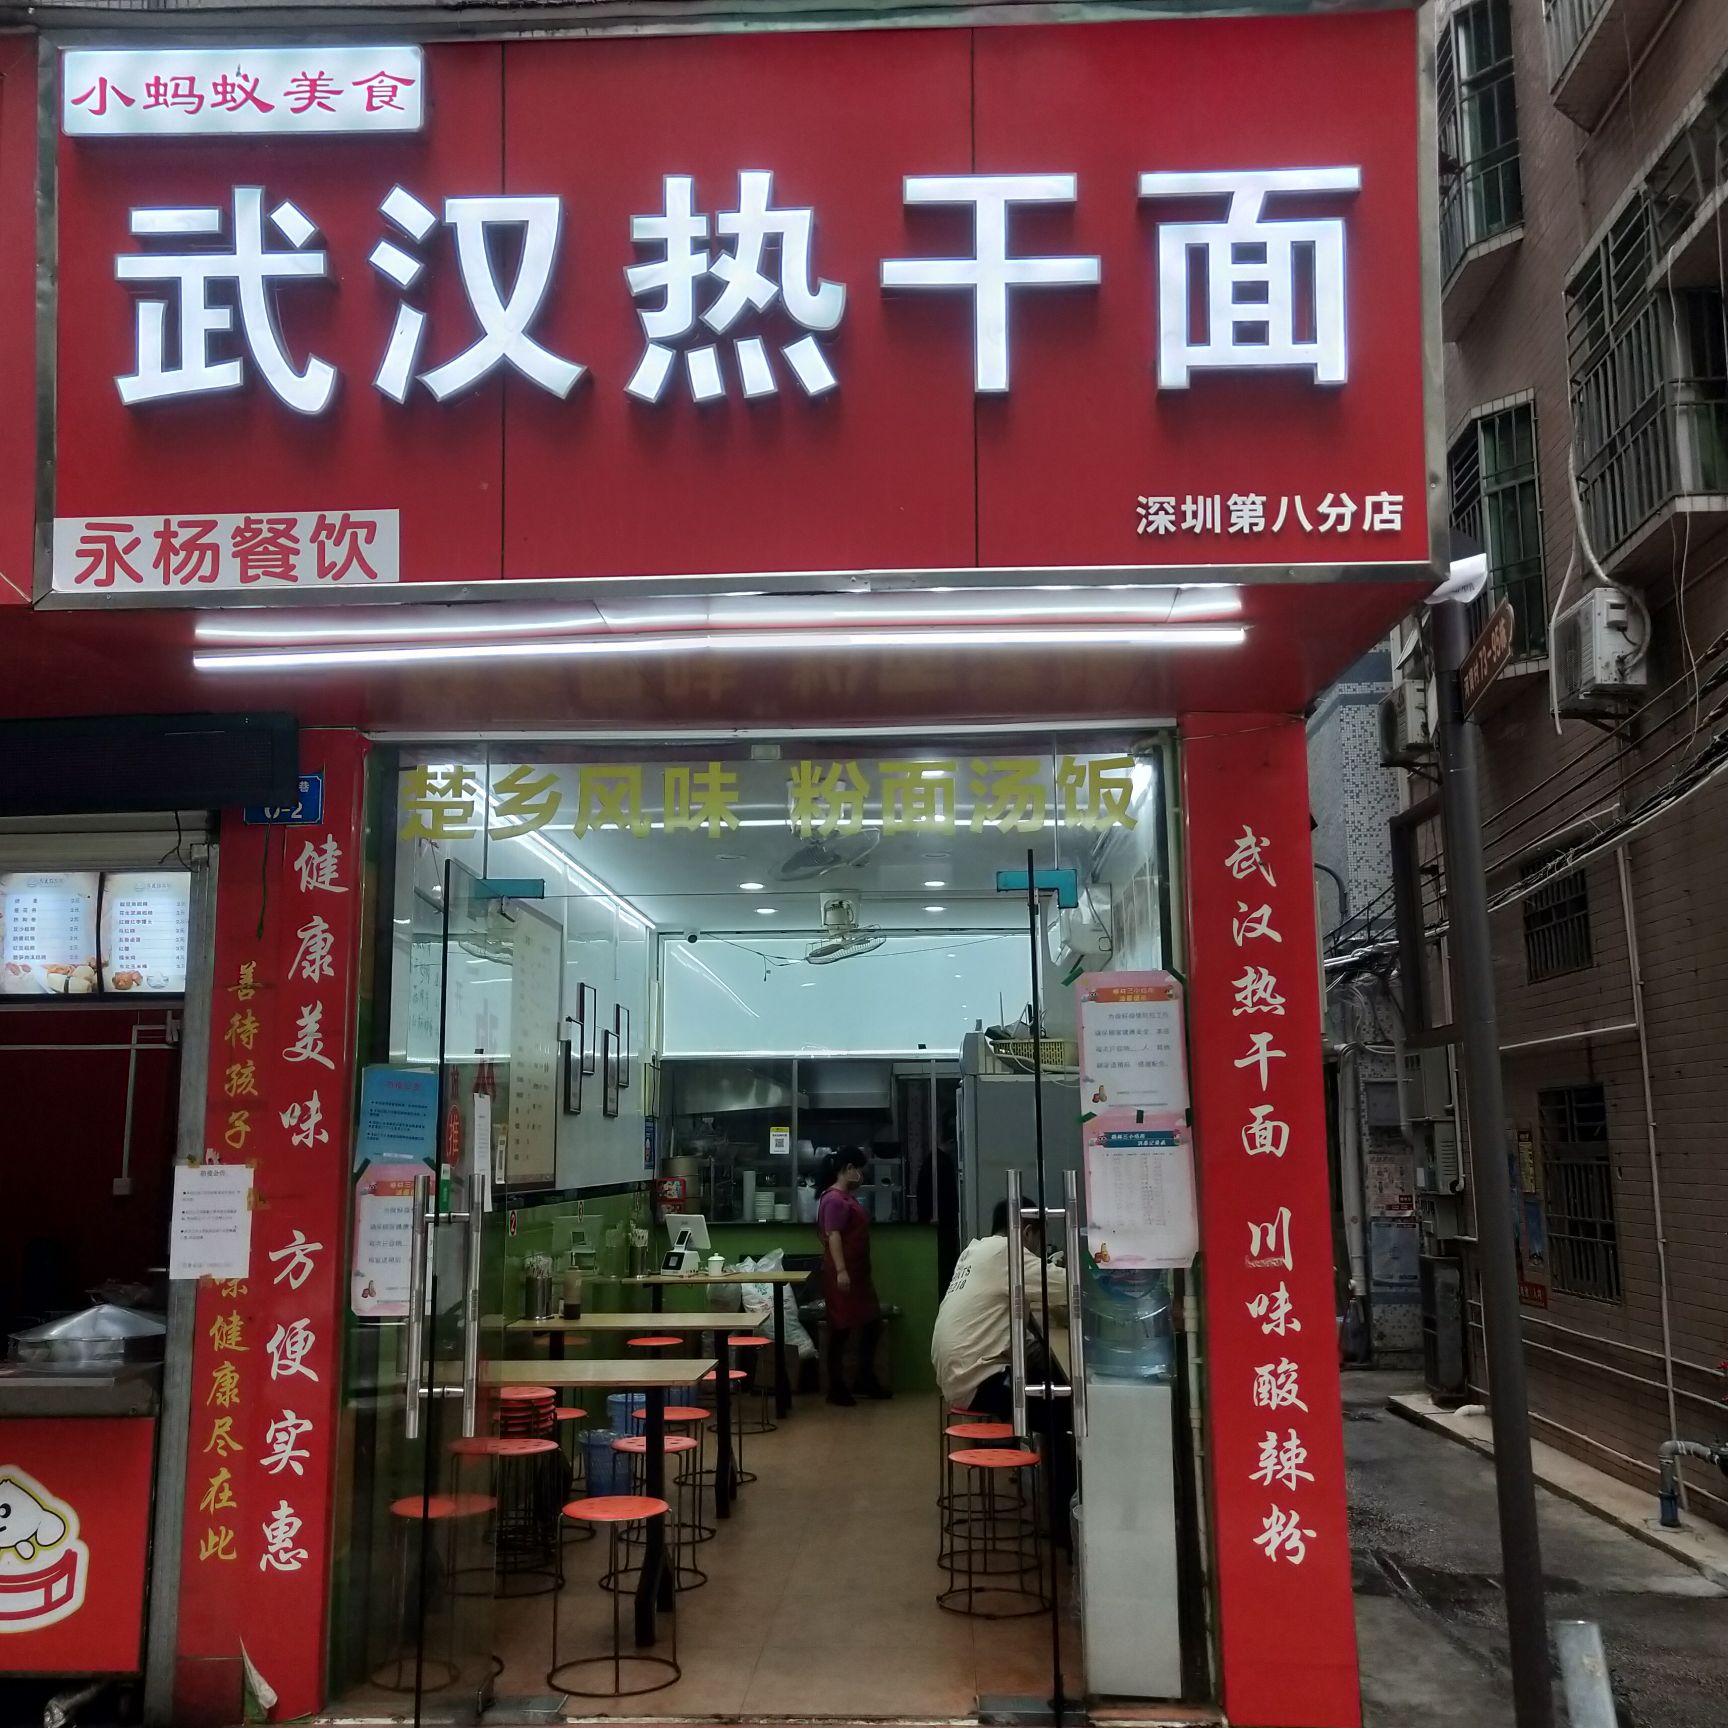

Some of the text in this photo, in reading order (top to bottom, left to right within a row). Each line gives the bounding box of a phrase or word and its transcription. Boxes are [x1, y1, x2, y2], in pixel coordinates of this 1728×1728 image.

[70, 69, 416, 115] 小蚂蚁美食
[113, 165, 1363, 416] 武汉热干面
[73, 510, 379, 588] 永杨餐饮
[1135, 491, 1405, 537] 深圳第八分店
[400, 756, 1139, 841] 楚乡风味 粉面汤饭
[223, 960, 264, 1149] 善待孩子
[258, 833, 350, 1573] 健康美味 方便实惠
[1224, 824, 1318, 1566] 武汉热干面 川味酸辣粉
